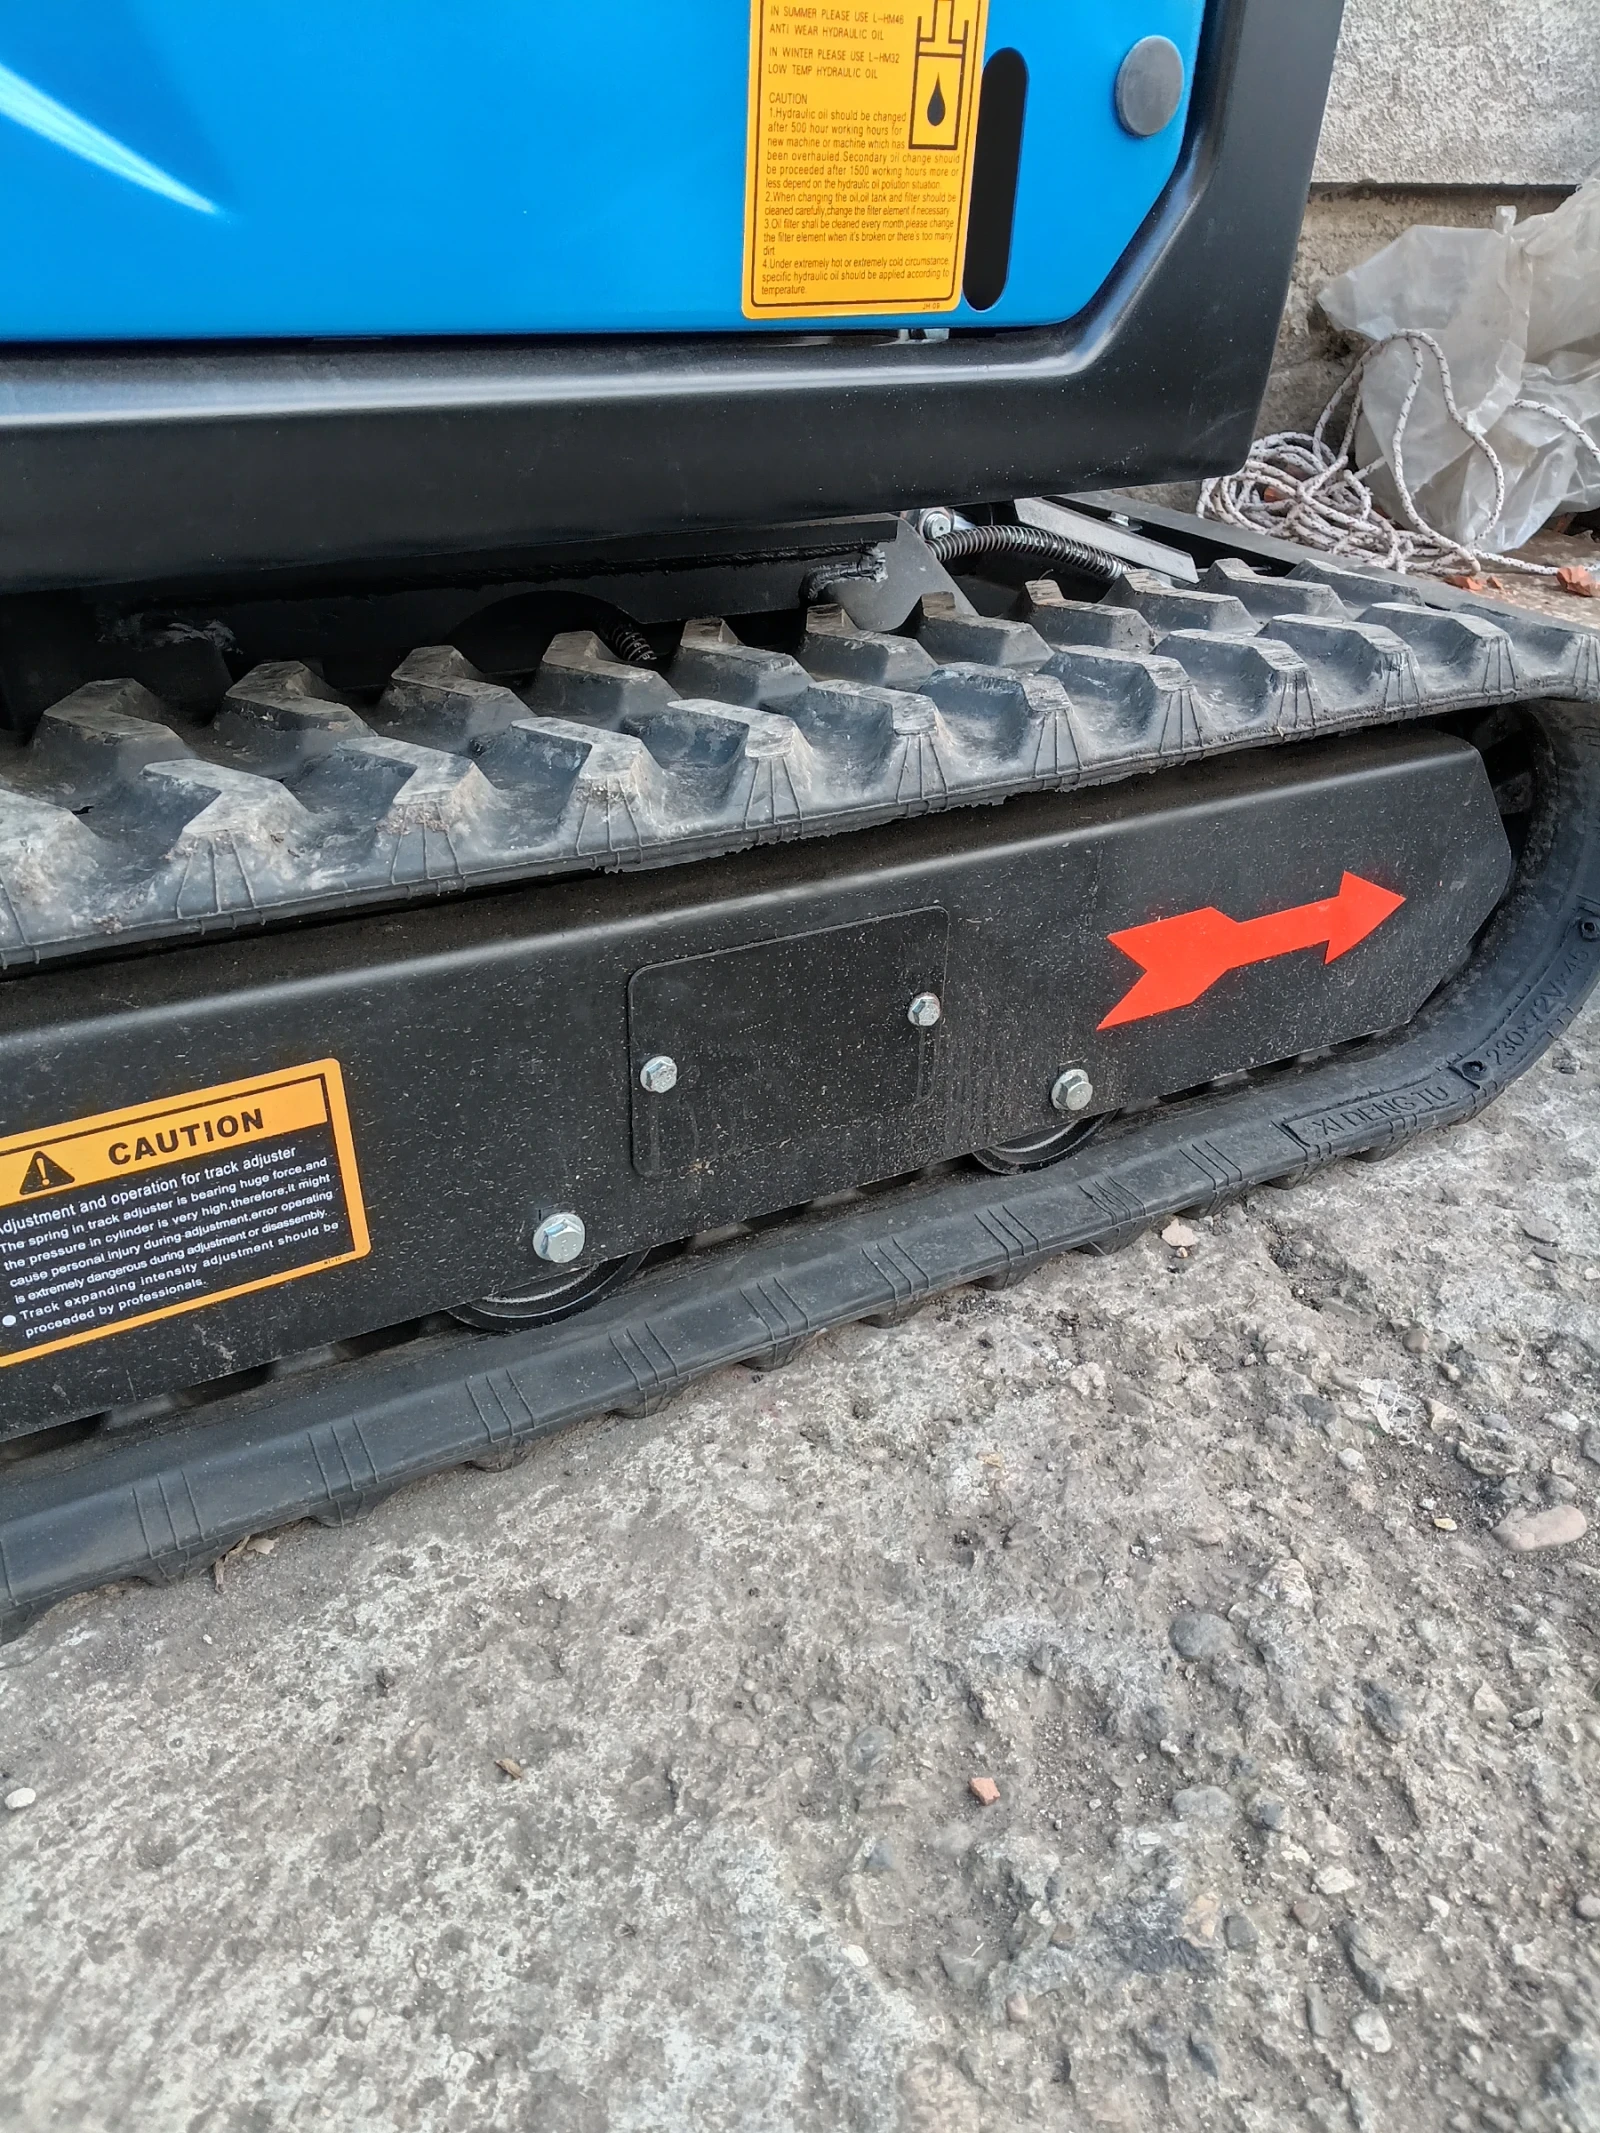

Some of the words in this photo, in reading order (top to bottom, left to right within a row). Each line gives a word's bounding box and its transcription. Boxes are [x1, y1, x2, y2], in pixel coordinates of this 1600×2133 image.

[770, 5, 779, 16] IN
[783, 6, 817, 18] SUMMER
[821, 9, 850, 20] PLEASE
[854, 11, 868, 22] USE
[769, 23, 789, 34] ANTI
[794, 24, 818, 36] WEAR
[823, 26, 867, 39] HYDRAULIC
[871, 29, 884, 40] OIL
[769, 46, 777, 57] IN
[782, 47, 813, 59] WINTER
[818, 49, 846, 60] PLEASE
[850, 51, 864, 61] USE
[869, 52, 900, 63] L-HM32
[768, 63, 787, 74] LOW
[792, 64, 812, 75] TEMP
[816, 66, 861, 77] HYDRAULIC
[865, 68, 878, 78] OIL
[769, 92, 807, 104] CAUTION
[769, 107, 815, 121] 1.Hydraulic
[818, 109, 828, 119] oil
[831, 109, 858, 120] should
[860, 110, 871, 120] be
[873, 111, 906, 124] changed
[768, 122, 787, 132] after
[791, 122, 806, 133] 500
[810, 123, 828, 133] hour
[831, 124, 863, 137] working
[866, 125, 888, 135] hours
[891, 125, 902, 135] for
[767, 138, 784, 146] new
[786, 136, 820, 147] machine
[833, 138, 866, 148] machine
[868, 139, 889, 149] which
[891, 139, 905, 149] has
[767, 150, 788, 160] been
[890, 153, 899, 162] oil
[902, 153, 931, 165] change
[934, 154, 960, 163] should
[766, 164, 777, 174] be
[779, 164, 824, 177] proceeded
[827, 165, 846, 175] after
[850, 165, 870, 175] 1500
[871, 166, 902, 178] working
[905, 166, 927, 176] hours
[765, 178, 781, 188] less
[783, 178, 811, 191] depend
[824, 179, 835, 188] the
[837, 179, 869, 191] hydraulic
[871, 179, 880, 189] oil
[765, 191, 796, 201] 2.When
[798, 192, 833, 204] changing
[835, 192, 847, 202] the
[871, 192, 887, 202] tank
[889, 193, 903, 202] and
[904, 193, 920, 202] filter
[922, 193, 945, 202] should
[947, 193, 956, 202] be
[764, 205, 793, 215] cleaned
[854, 206, 865, 215] the
[867, 206, 881, 215] filter
[883, 206, 909, 215] element
[910, 206, 915, 215] if
[764, 219, 782, 228] 3.Oil
[783, 219, 799, 228] filter
[801, 219, 819, 228] shall
[821, 219, 830, 228] be
[832, 219, 860, 228] cleaned
[861, 221, 881, 230] every
[929, 219, 954, 230] change
[764, 232, 775, 242] the
[778, 232, 794, 242] filter
[796, 232, 826, 242] element
[827, 232, 847, 242] when
[849, 232, 860, 241] it's
[861, 232, 886, 241] broken
[897, 232, 920, 241] there's
[921, 232, 933, 241] too
[934, 234, 953, 243] many
[762, 258, 792, 268] 4.Under
[794, 258, 829, 270] extremely
[831, 258, 842, 267] hot
[853, 257, 888, 269] extremely
[889, 257, 903, 266] cold
[762, 271, 791, 284] specific
[793, 271, 828, 283] hydraulic
[830, 270, 839, 280] oil
[841, 270, 866, 280] should
[867, 270, 877, 279] be
[878, 269, 905, 281] applied
[906, 269, 941, 281] according
[942, 269, 950, 278] to
[109, 1109, 263, 1165] CAUTION
[79, 1195, 107, 1213] and
[111, 1179, 178, 1205] operation
[181, 1173, 200, 1185] for
[205, 1161, 239, 1179] track
[243, 1148, 295, 1169] adjuster
[0, 1241, 25, 1253] The
[29, 1229, 69, 1246] spring
[72, 1225, 84, 1233] in
[88, 1215, 120, 1229] track
[124, 1201, 173, 1220] adjuster
[177, 1197, 187, 1205] is
[191, 1184, 236, 1202] bearing
[240, 1175, 269, 1188] huge
[273, 1157, 327, 1179] force,and
[4, 1259, 25, 1271] the
[29, 1243, 86, 1265] pressure
[89, 1238, 101, 1247] in
[106, 1223, 154, 1243] cylinder
[158, 1219, 168, 1228] is
[172, 1211, 198, 1224] very
[202, 1184, 295, 1216] high,therefore,it
[299, 1174, 330, 1189] might
[10, 1271, 48, 1287] cause
[51, 1253, 105, 1277] personal
[108, 1245, 140, 1262] injury
[144, 1234, 181, 1249] during
[185, 1206, 278, 1238] adjustment,error
[281, 1191, 333, 1211] operating
[15, 1295, 25, 1304] is
[28, 1278, 84, 1300] extremely
[87, 1261, 147, 1283] dangerous
[150, 1250, 185, 1265] during
[187, 1231, 246, 1254] adjustment
[248, 1228, 259, 1237] or
[262, 1209, 327, 1233] disassembly.
[20, 1303, 60, 1319] Track
[65, 1282, 135, 1307] expanding
[141, 1263, 197, 1285] intensity
[203, 1240, 274, 1267] adjustment
[278, 1226, 319, 1245] should
[324, 1223, 338, 1232] be
[26, 1309, 95, 1338] proceeded
[99, 1305, 114, 1315] by
[119, 1279, 206, 1311] professionals.
